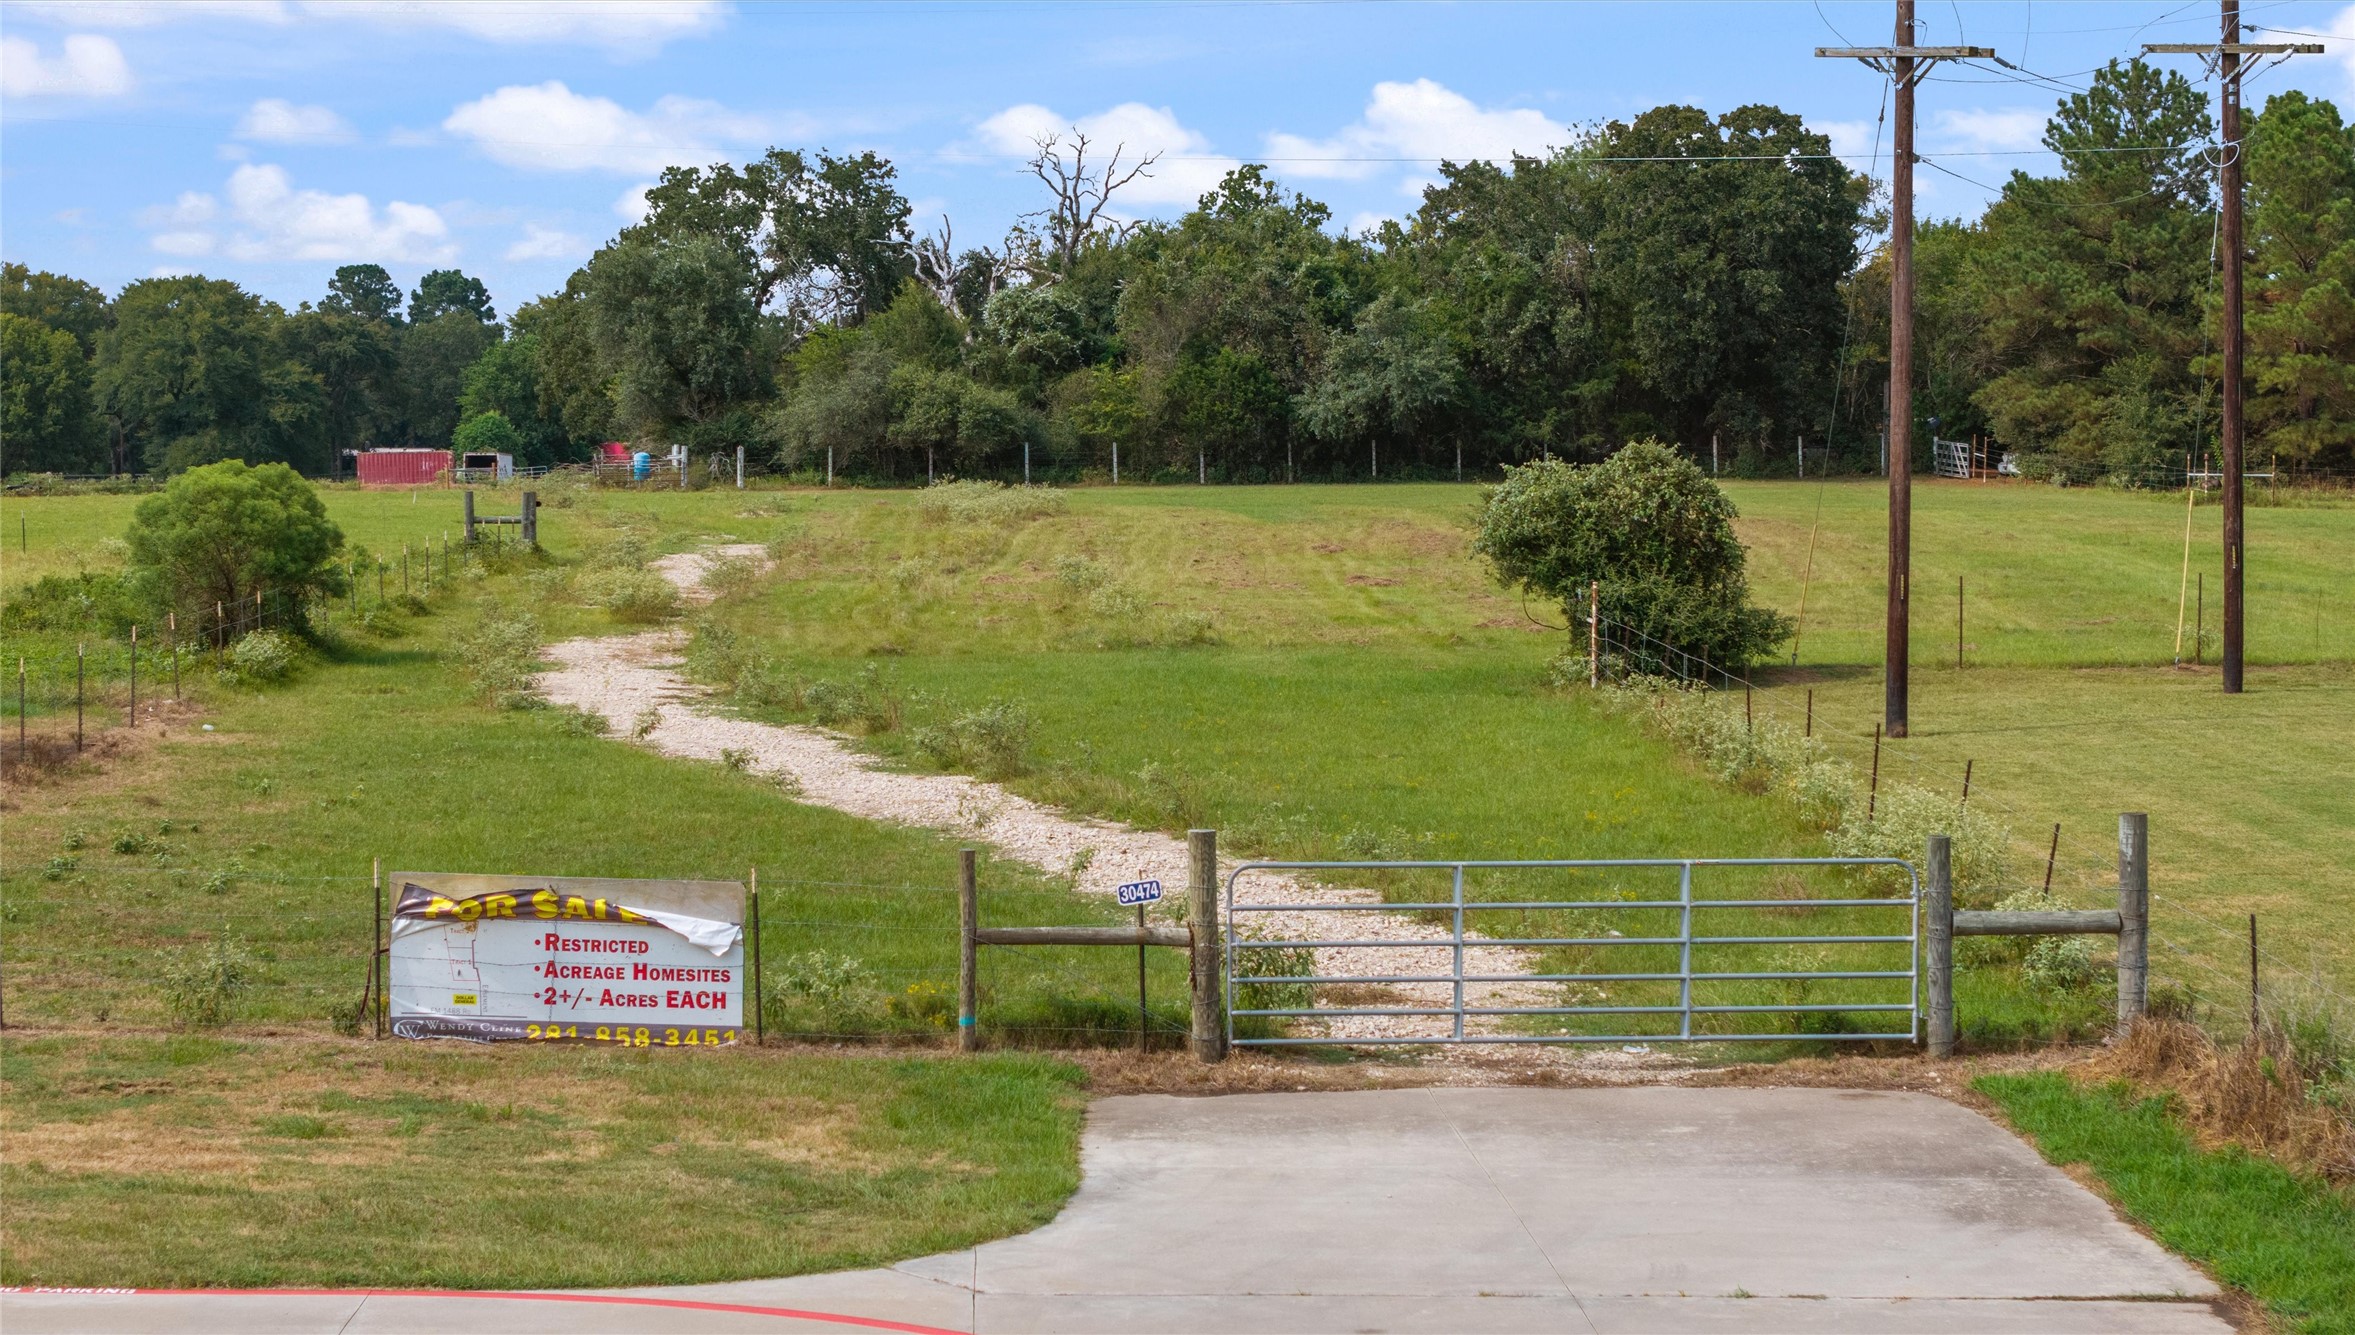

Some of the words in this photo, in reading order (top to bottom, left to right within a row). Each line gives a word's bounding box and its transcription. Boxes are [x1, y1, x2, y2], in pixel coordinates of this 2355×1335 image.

[1120, 882, 1159, 902] 30474
[425, 894, 517, 922] FOR
[545, 933, 649, 954] RESTRICTED
[543, 960, 625, 980] ACREAGE
[633, 963, 731, 982] HOMESITES
[599, 988, 658, 1008] ACRES
[666, 990, 727, 1009] EACH
[424, 1020, 474, 1031] WENDY
